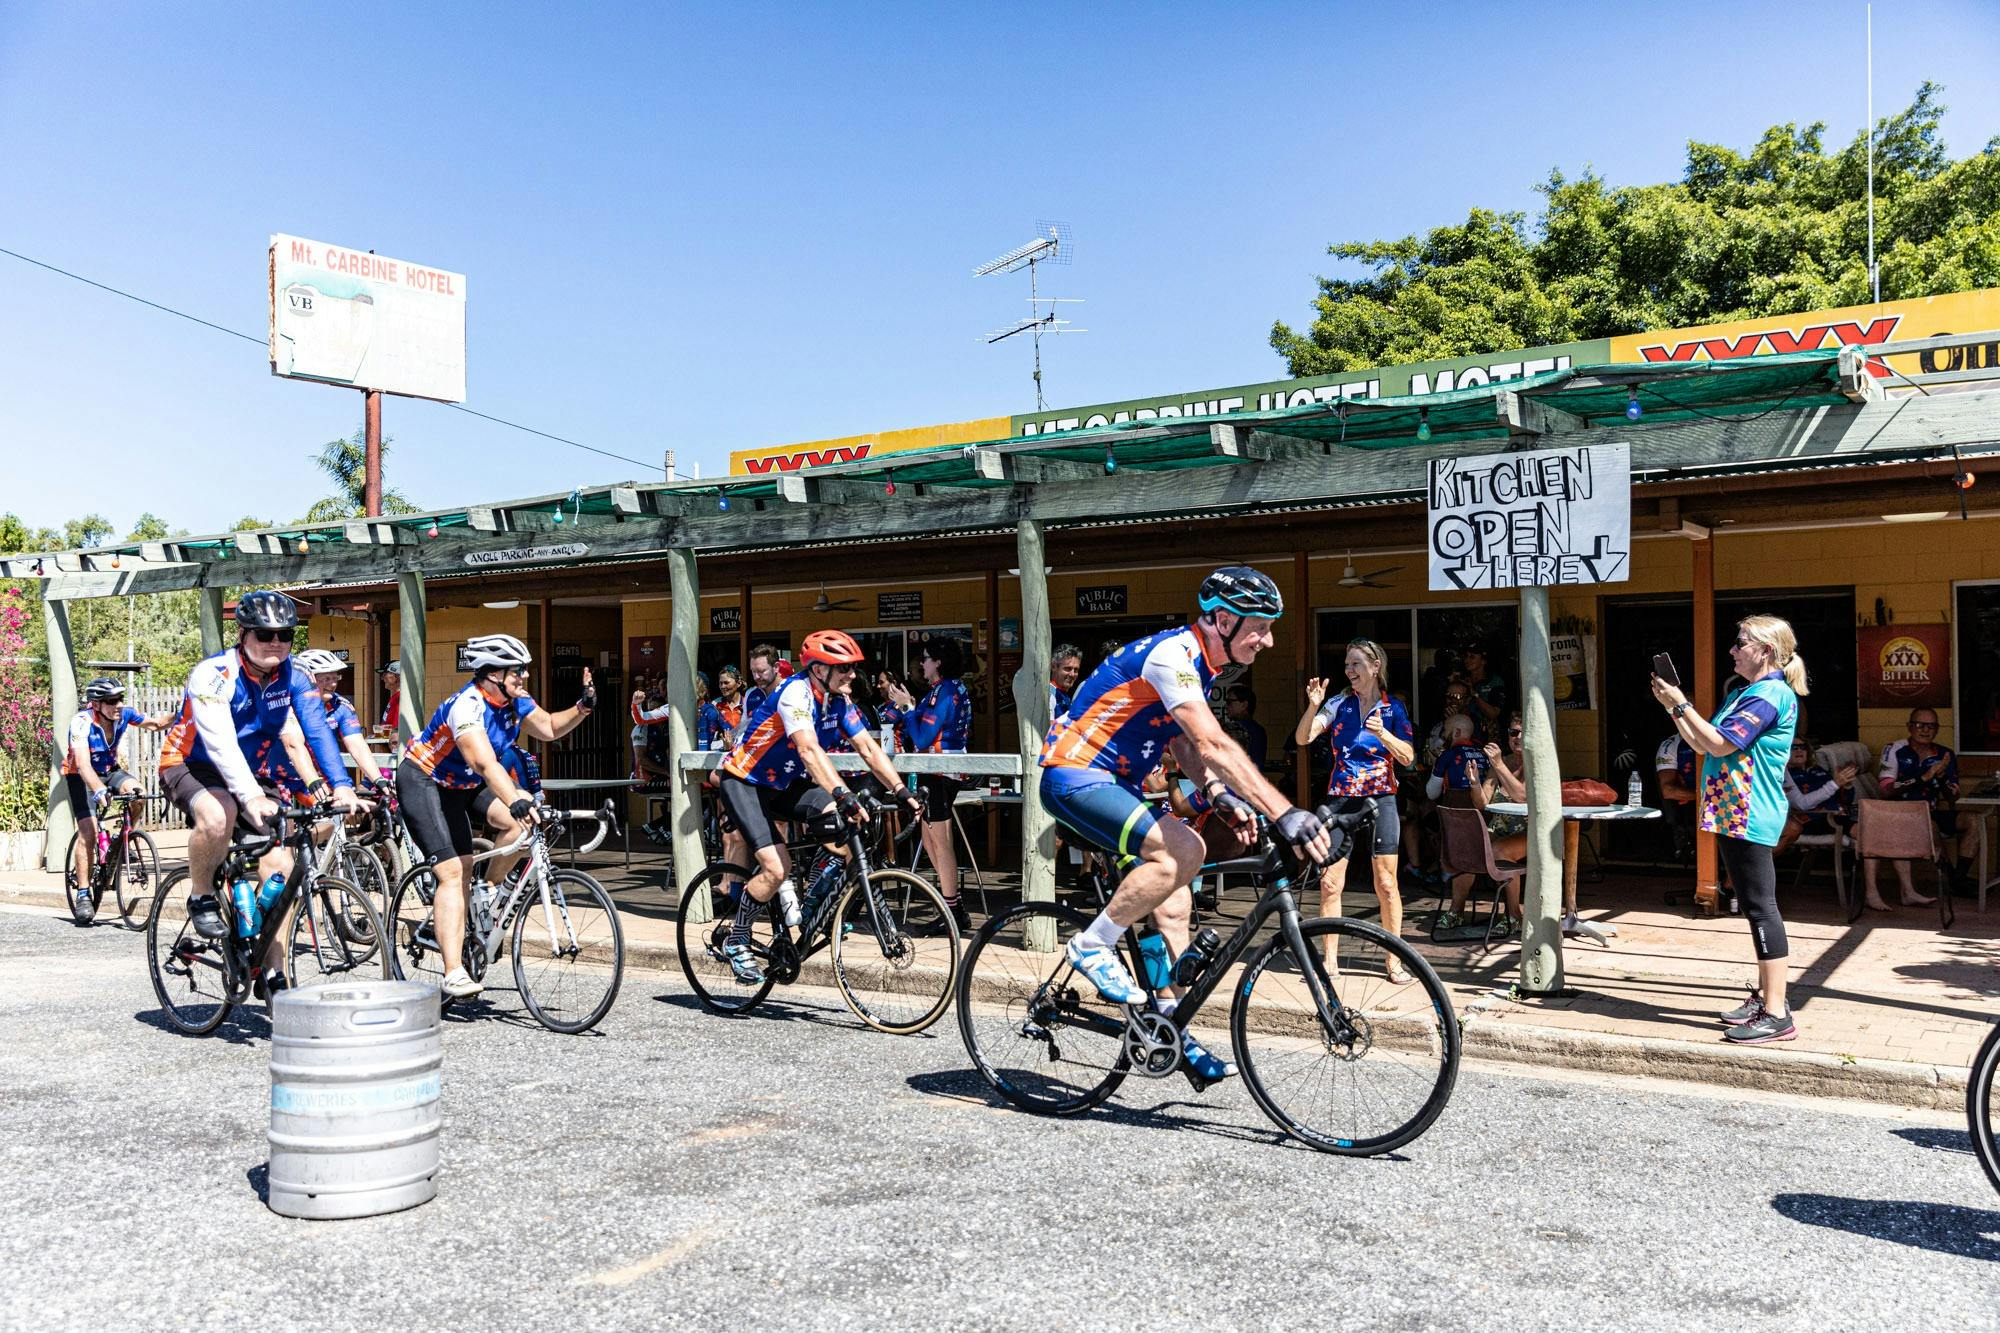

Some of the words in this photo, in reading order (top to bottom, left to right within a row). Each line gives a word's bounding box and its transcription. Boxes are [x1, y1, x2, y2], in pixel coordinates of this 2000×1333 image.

[291, 241, 317, 266] Mt.
[326, 249, 398, 282] CARBINE
[406, 267, 455, 295] HOTEL
[289, 295, 312, 309] VB
[1430, 448, 1592, 510] KITCHEN
[1433, 499, 1571, 563] OPEN
[471, 552, 499, 563] ANGLE
[1491, 554, 1581, 587] HERE
[1078, 589, 1124, 607] PUBLIC
[1090, 602, 1112, 612] BAR
[720, 620, 737, 629] BAR
[556, 646, 580, 656] GENTS
[1550, 638, 1580, 651] rona
[1551, 653, 1572, 662] xtra
[1883, 652, 1927, 667] XXXX
[1882, 670, 1930, 681] BITTER
[502, 879, 533, 930] GIANT
